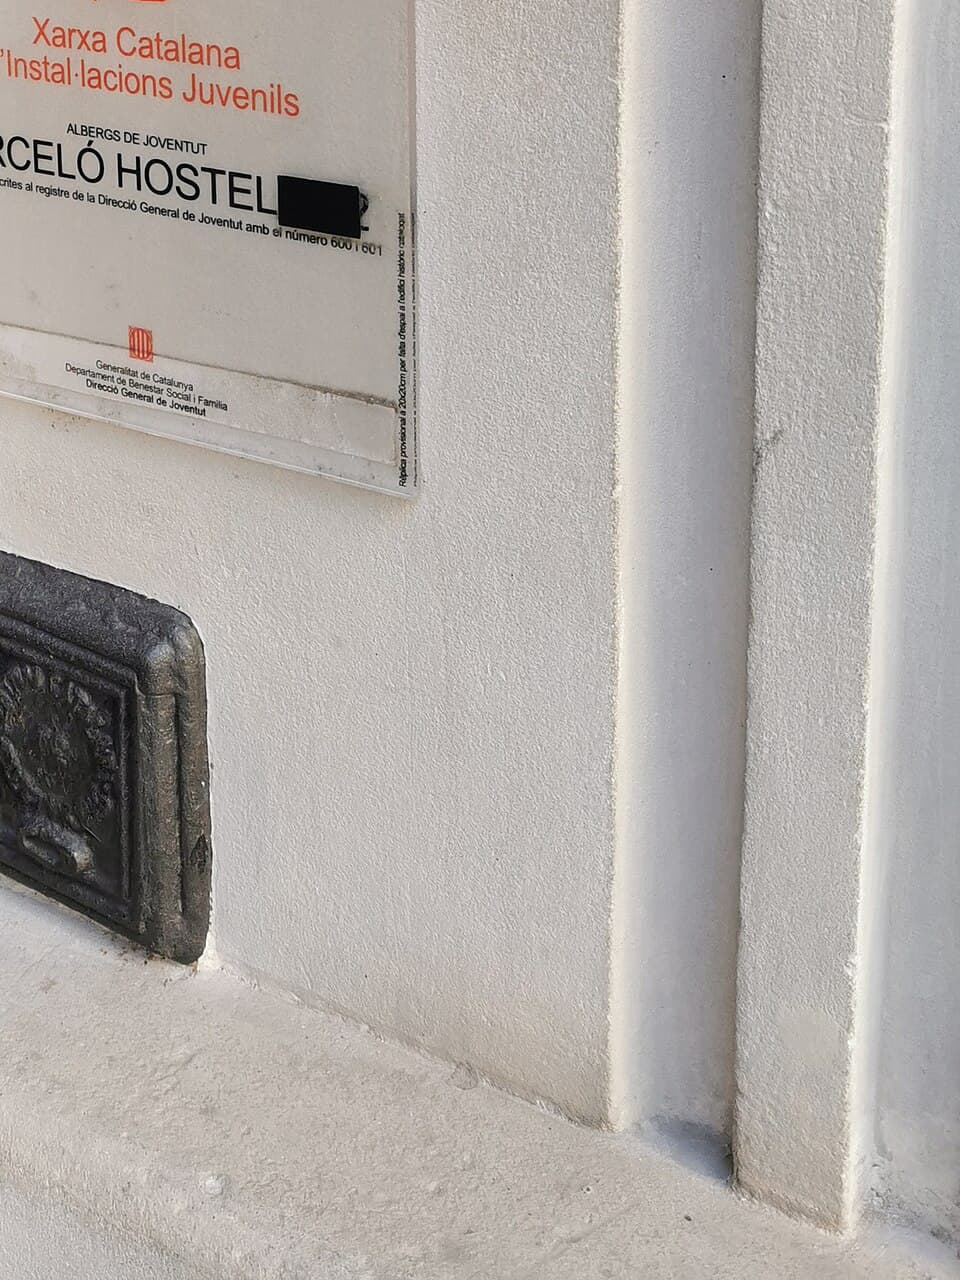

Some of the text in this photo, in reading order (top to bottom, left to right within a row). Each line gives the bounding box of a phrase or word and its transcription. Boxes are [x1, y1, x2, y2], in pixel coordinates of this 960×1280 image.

[32, 16, 241, 70] Xarxa Catalana
[182, 73, 300, 117] Juvenils
[66, 122, 208, 155] ALBERGS DE JOVENTUT
[117, 152, 278, 216] HOSTEL
[24, 181, 33, 192] al
[36, 185, 70, 199] registre
[72, 190, 84, 201] de
[86, 192, 96, 204] la
[98, 194, 138, 211] Direcció
[140, 202, 180, 219] General
[182, 209, 196, 222] de
[198, 212, 243, 231] Joventut
[245, 222, 270, 236] amb
[285, 229, 328, 247] número
[330, 236, 352, 252] 600
[361, 241, 383, 257] 601
[65, 362, 115, 384] Departament
[116, 376, 127, 386] de
[128, 379, 164, 396] Benestar
[166, 388, 192, 403] Social
[95, 359, 194, 392] Generalitat de Catalunya
[399, 358, 408, 372] per
[86, 378, 207, 417] Direcció General de Joventut
